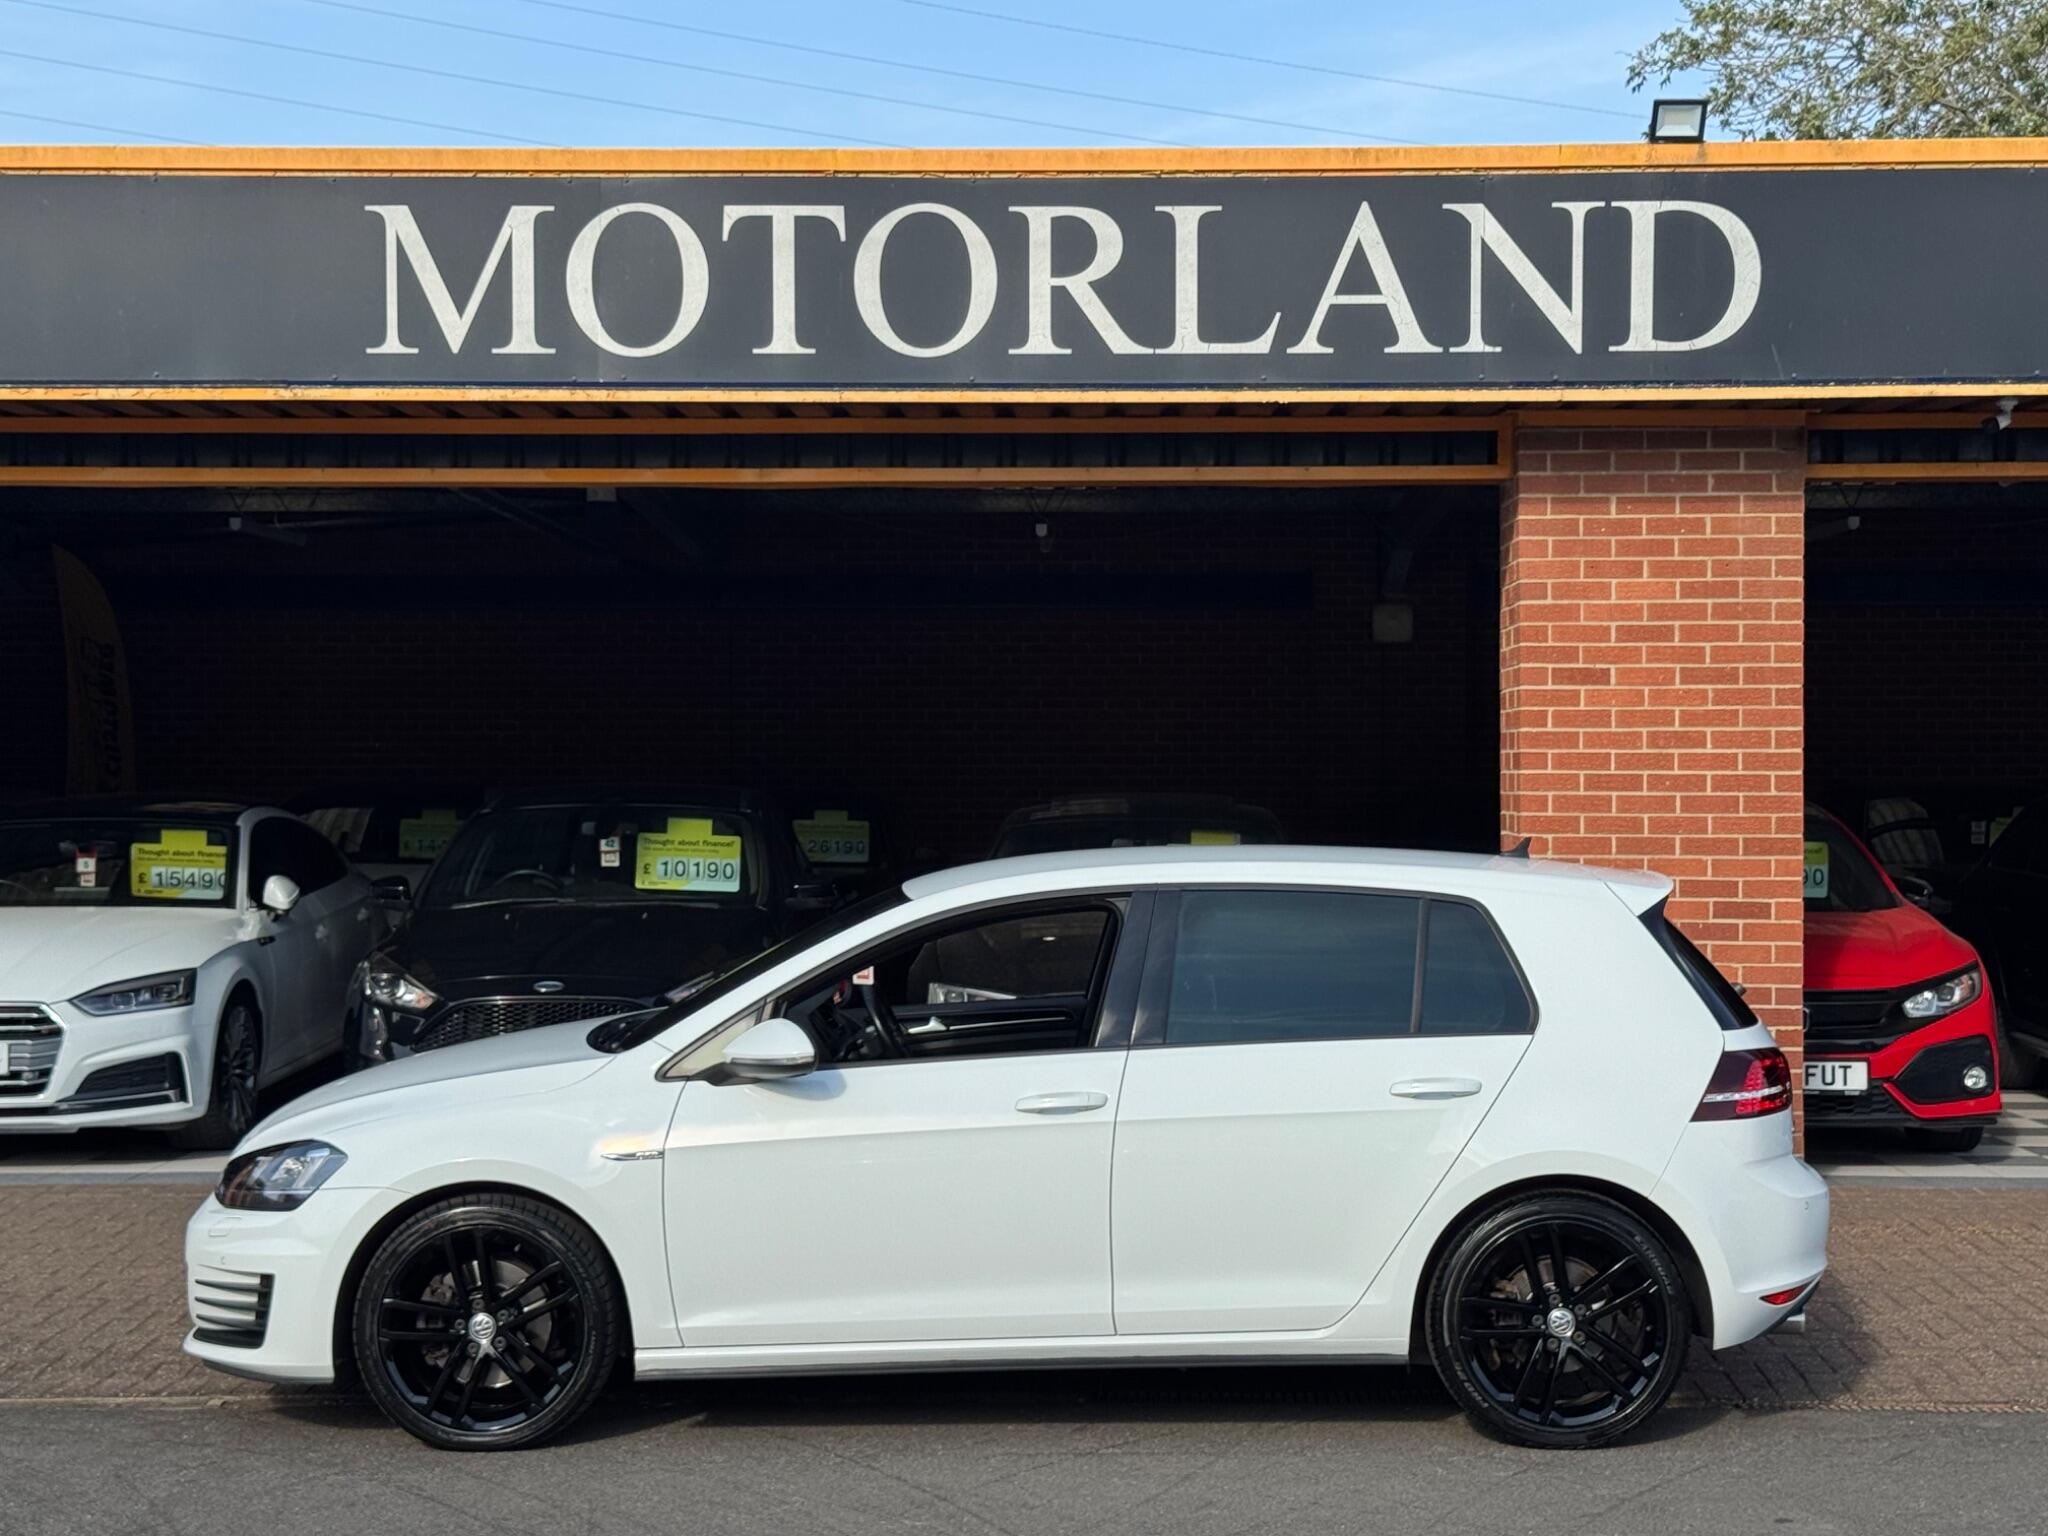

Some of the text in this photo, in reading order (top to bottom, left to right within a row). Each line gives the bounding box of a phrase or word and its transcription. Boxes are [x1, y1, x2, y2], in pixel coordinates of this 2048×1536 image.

[365, 200, 1762, 358] MOTORLAND
[172, 849, 195, 857] about
[808, 839, 865, 855] 26190
[660, 860, 735, 880] 10190
[1805, 1064, 1852, 1087] FUT
